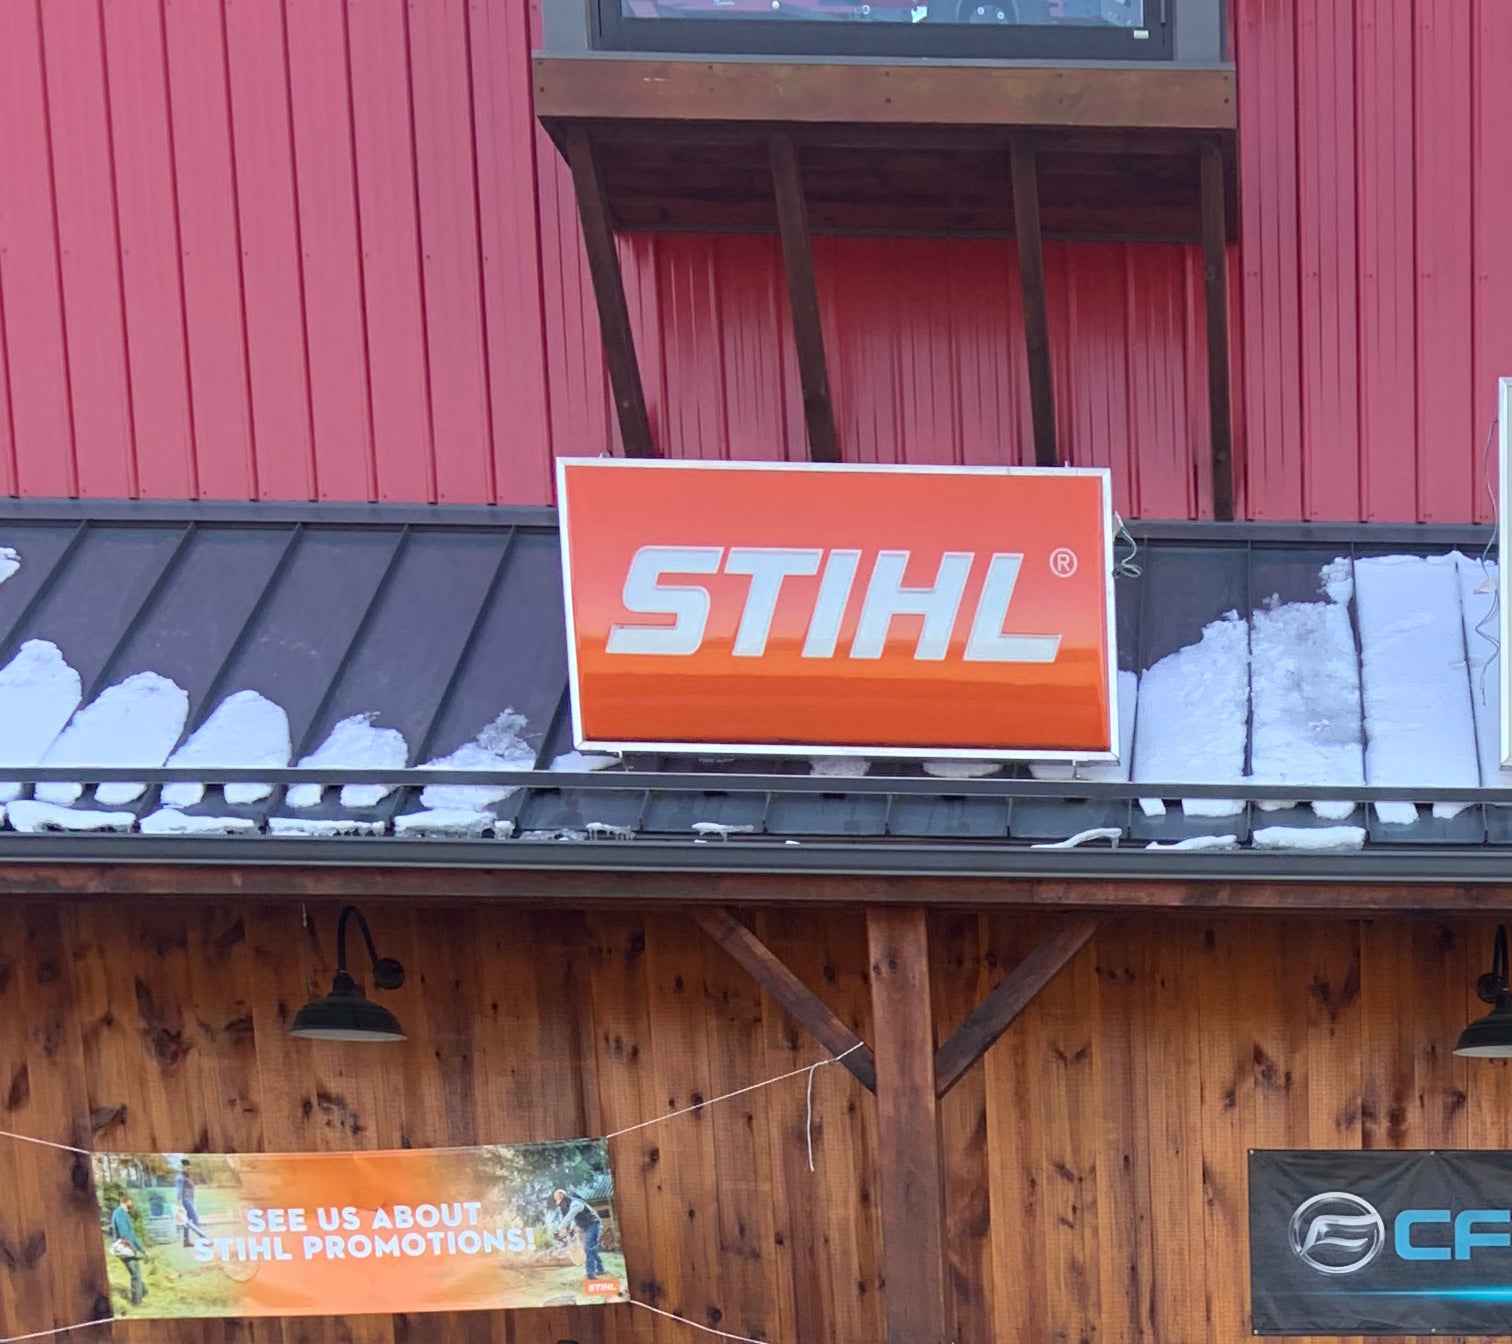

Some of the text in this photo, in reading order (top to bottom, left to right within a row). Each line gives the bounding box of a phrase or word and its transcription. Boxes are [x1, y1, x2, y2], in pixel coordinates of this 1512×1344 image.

[247, 1202, 482, 1233] SEE US ABOUT
[194, 1227, 537, 1262] STIHL PROMOTIONS!
